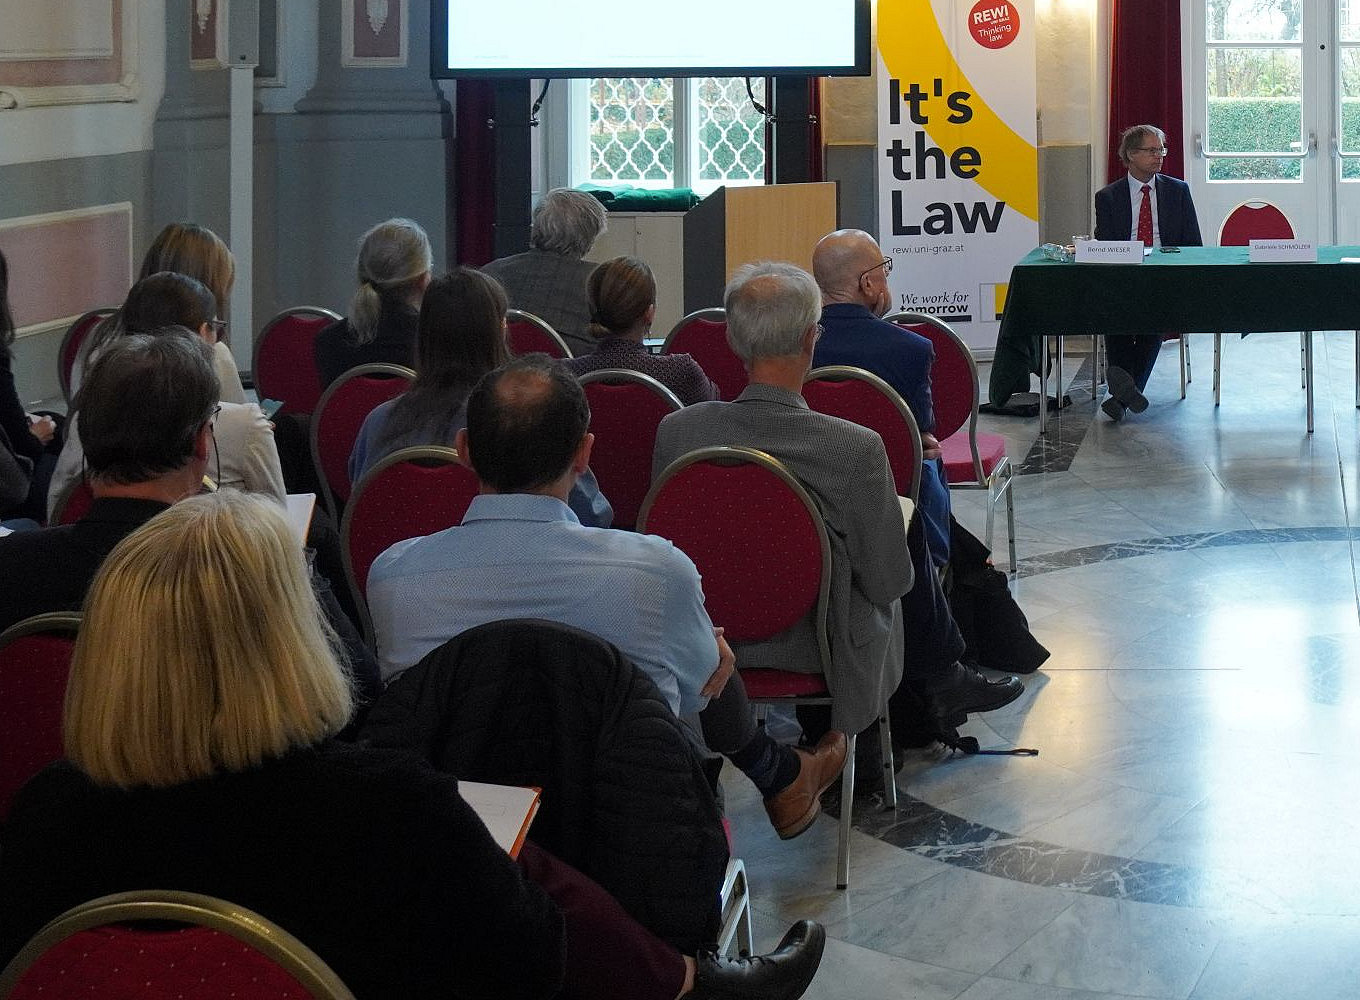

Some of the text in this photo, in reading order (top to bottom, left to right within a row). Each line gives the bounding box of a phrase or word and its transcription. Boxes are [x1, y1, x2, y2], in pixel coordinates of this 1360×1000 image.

[973, 5, 1009, 24] REWI
[978, 24, 1012, 37] Thinking
[990, 34, 1003, 42] law
[889, 78, 974, 125] It's
[886, 131, 982, 181] the
[891, 190, 1006, 236] Law
[892, 244, 965, 255] rewi.uni-graz.at
[901, 291, 969, 305] We work for
